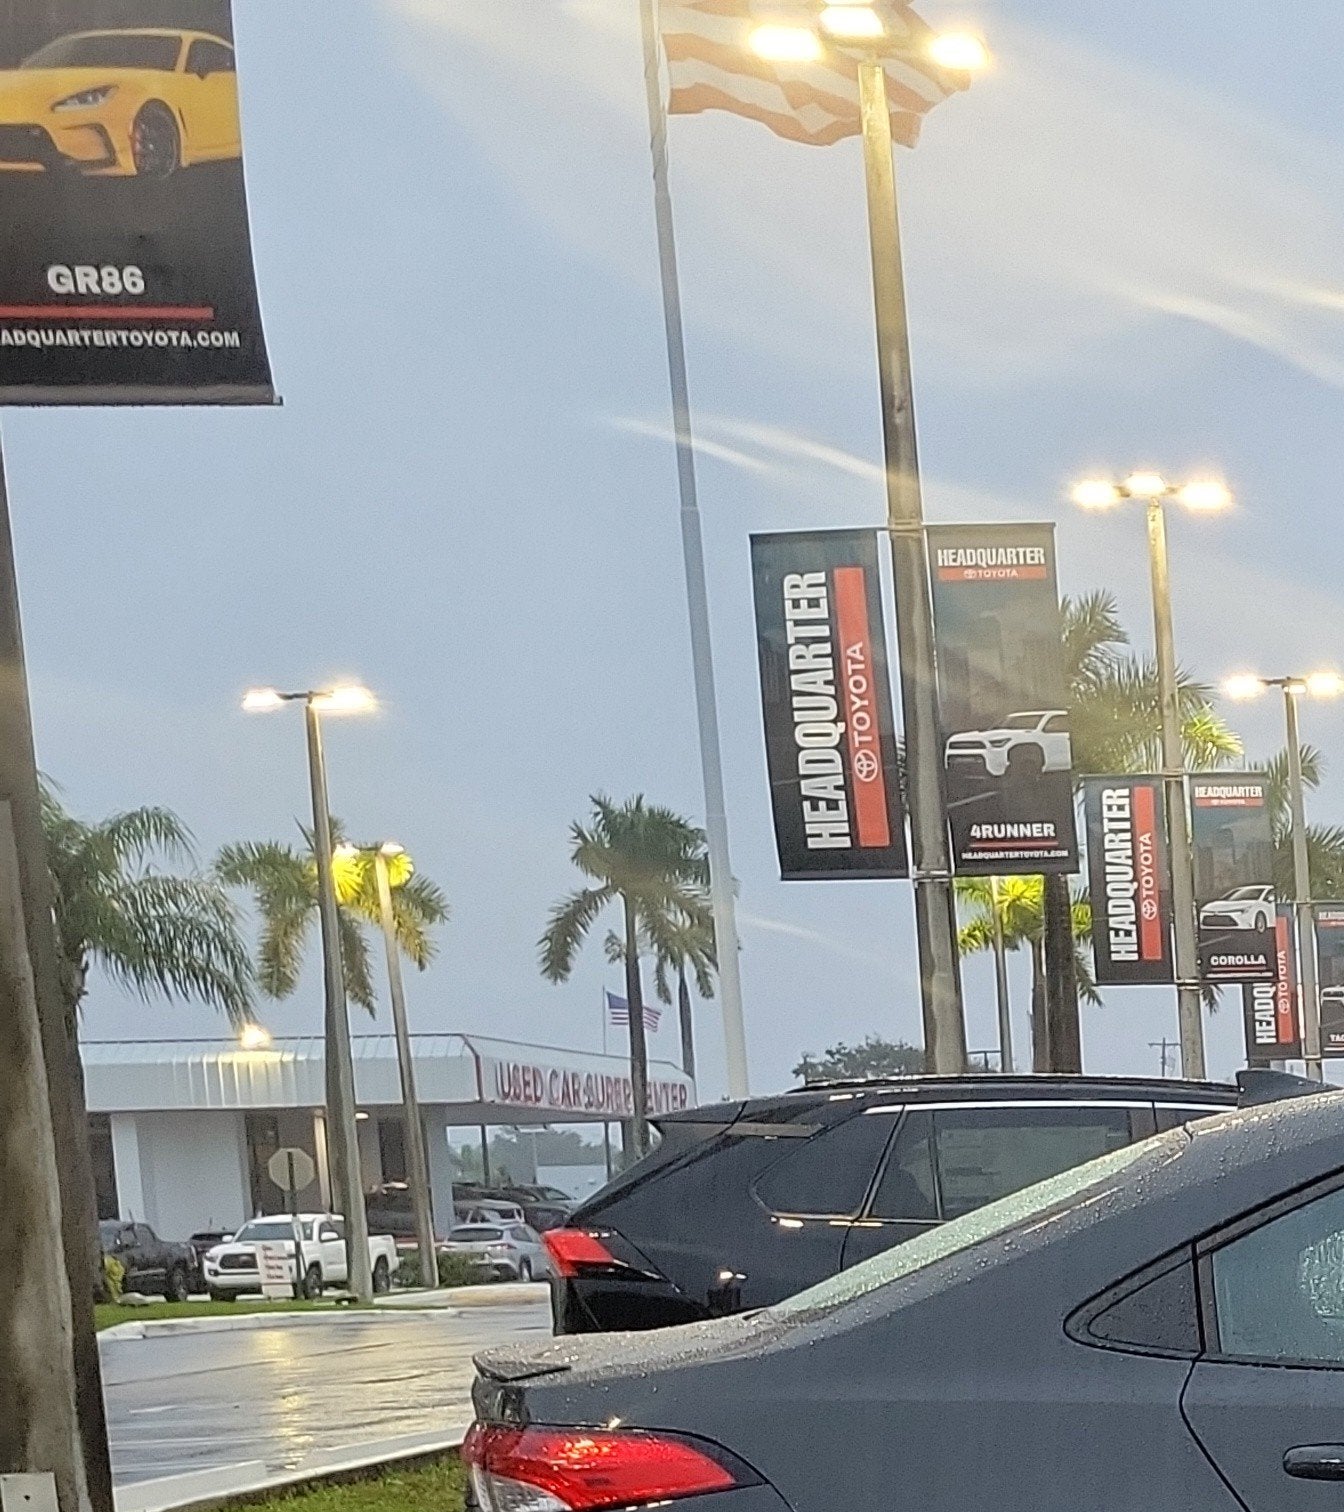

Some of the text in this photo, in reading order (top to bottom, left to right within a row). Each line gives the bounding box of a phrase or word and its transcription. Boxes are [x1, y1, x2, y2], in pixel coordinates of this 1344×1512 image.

[47, 265, 145, 294] GR86
[0, 328, 241, 348] ADQUARTERTOYOTA.COM
[937, 547, 1046, 567] HEADQUARTER
[978, 568, 1019, 578] TOYOTA
[847, 641, 872, 745] TOYOTA
[783, 570, 852, 849] HEADQUARTER
[970, 823, 1056, 839] 4RUNNER
[1102, 788, 1139, 961] HEADQUARTER
[1139, 832, 1154, 899] TOYOTA
[1210, 954, 1267, 966] COROLLA
[495, 1061, 545, 1104] USED
[549, 1067, 581, 1108] CAR
[646, 1081, 688, 1115] ENTER
